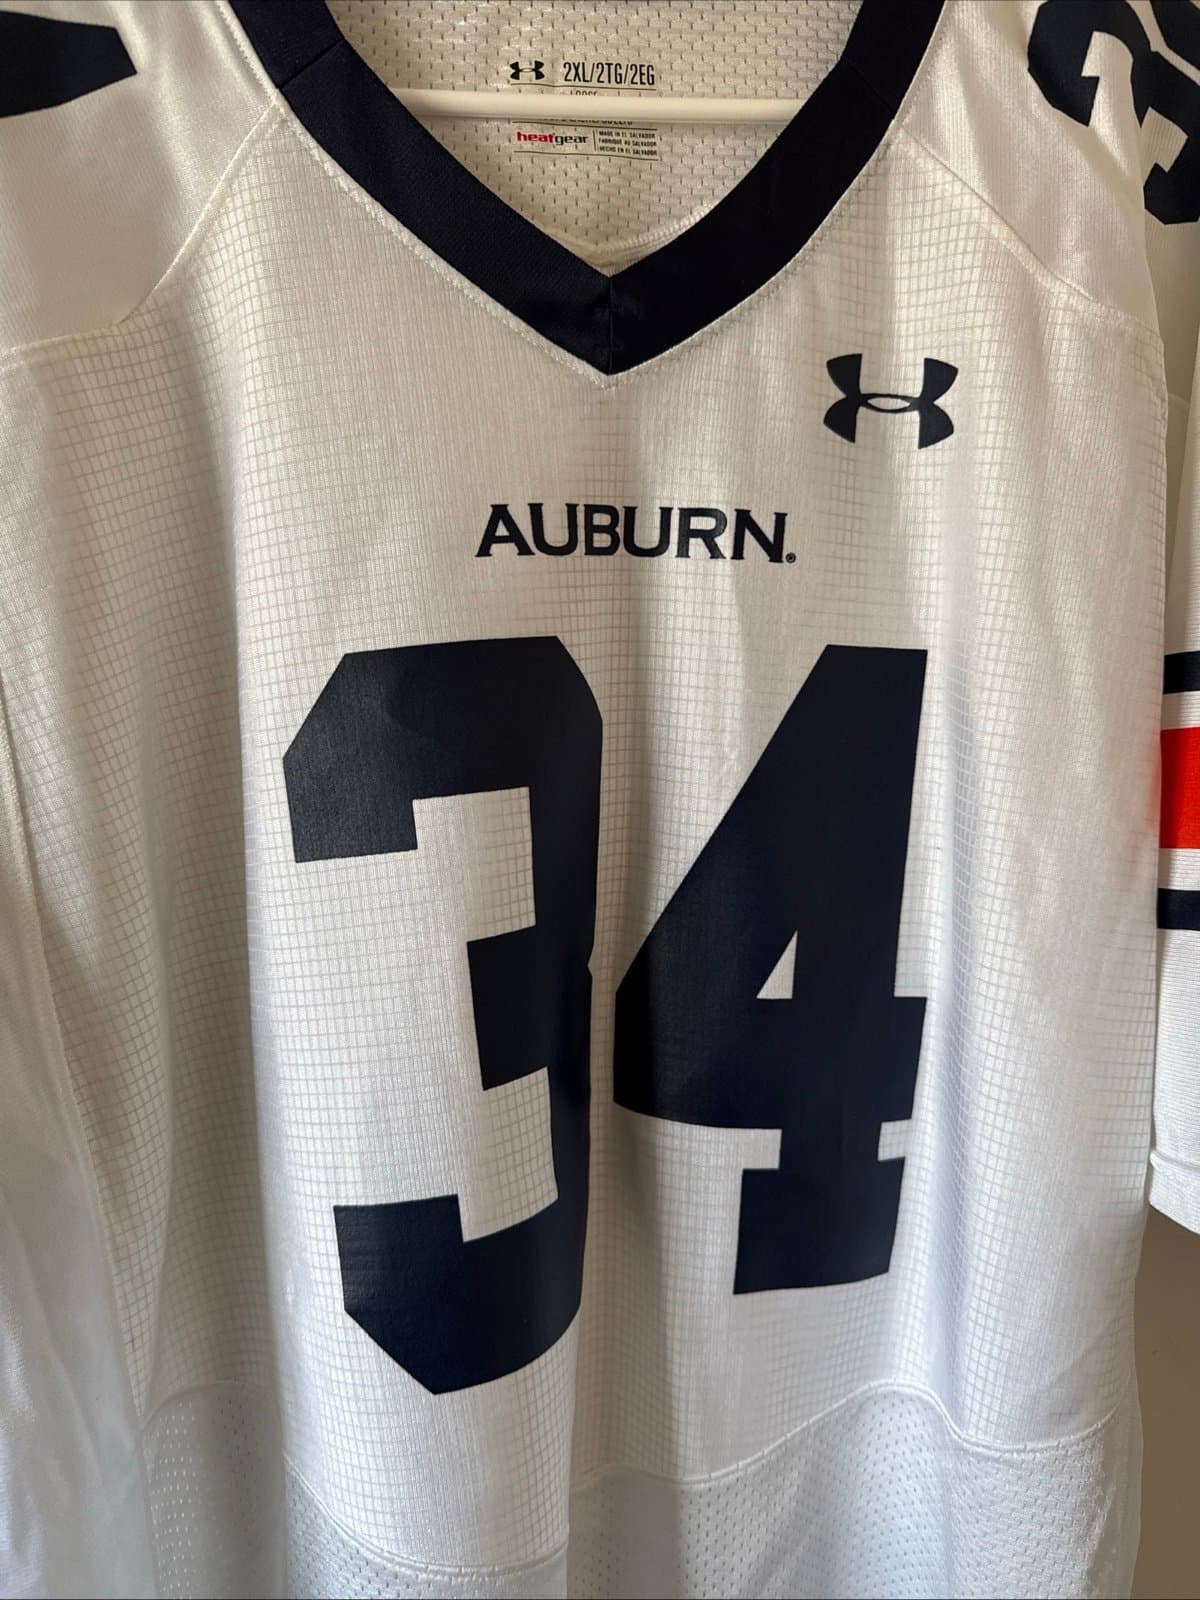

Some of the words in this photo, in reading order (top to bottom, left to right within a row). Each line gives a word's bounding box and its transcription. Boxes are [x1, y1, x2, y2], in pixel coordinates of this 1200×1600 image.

[563, 61, 656, 86] 2XL/2TG/2EG
[516, 131, 588, 146] heatgear
[283, 636, 929, 1394] 34
